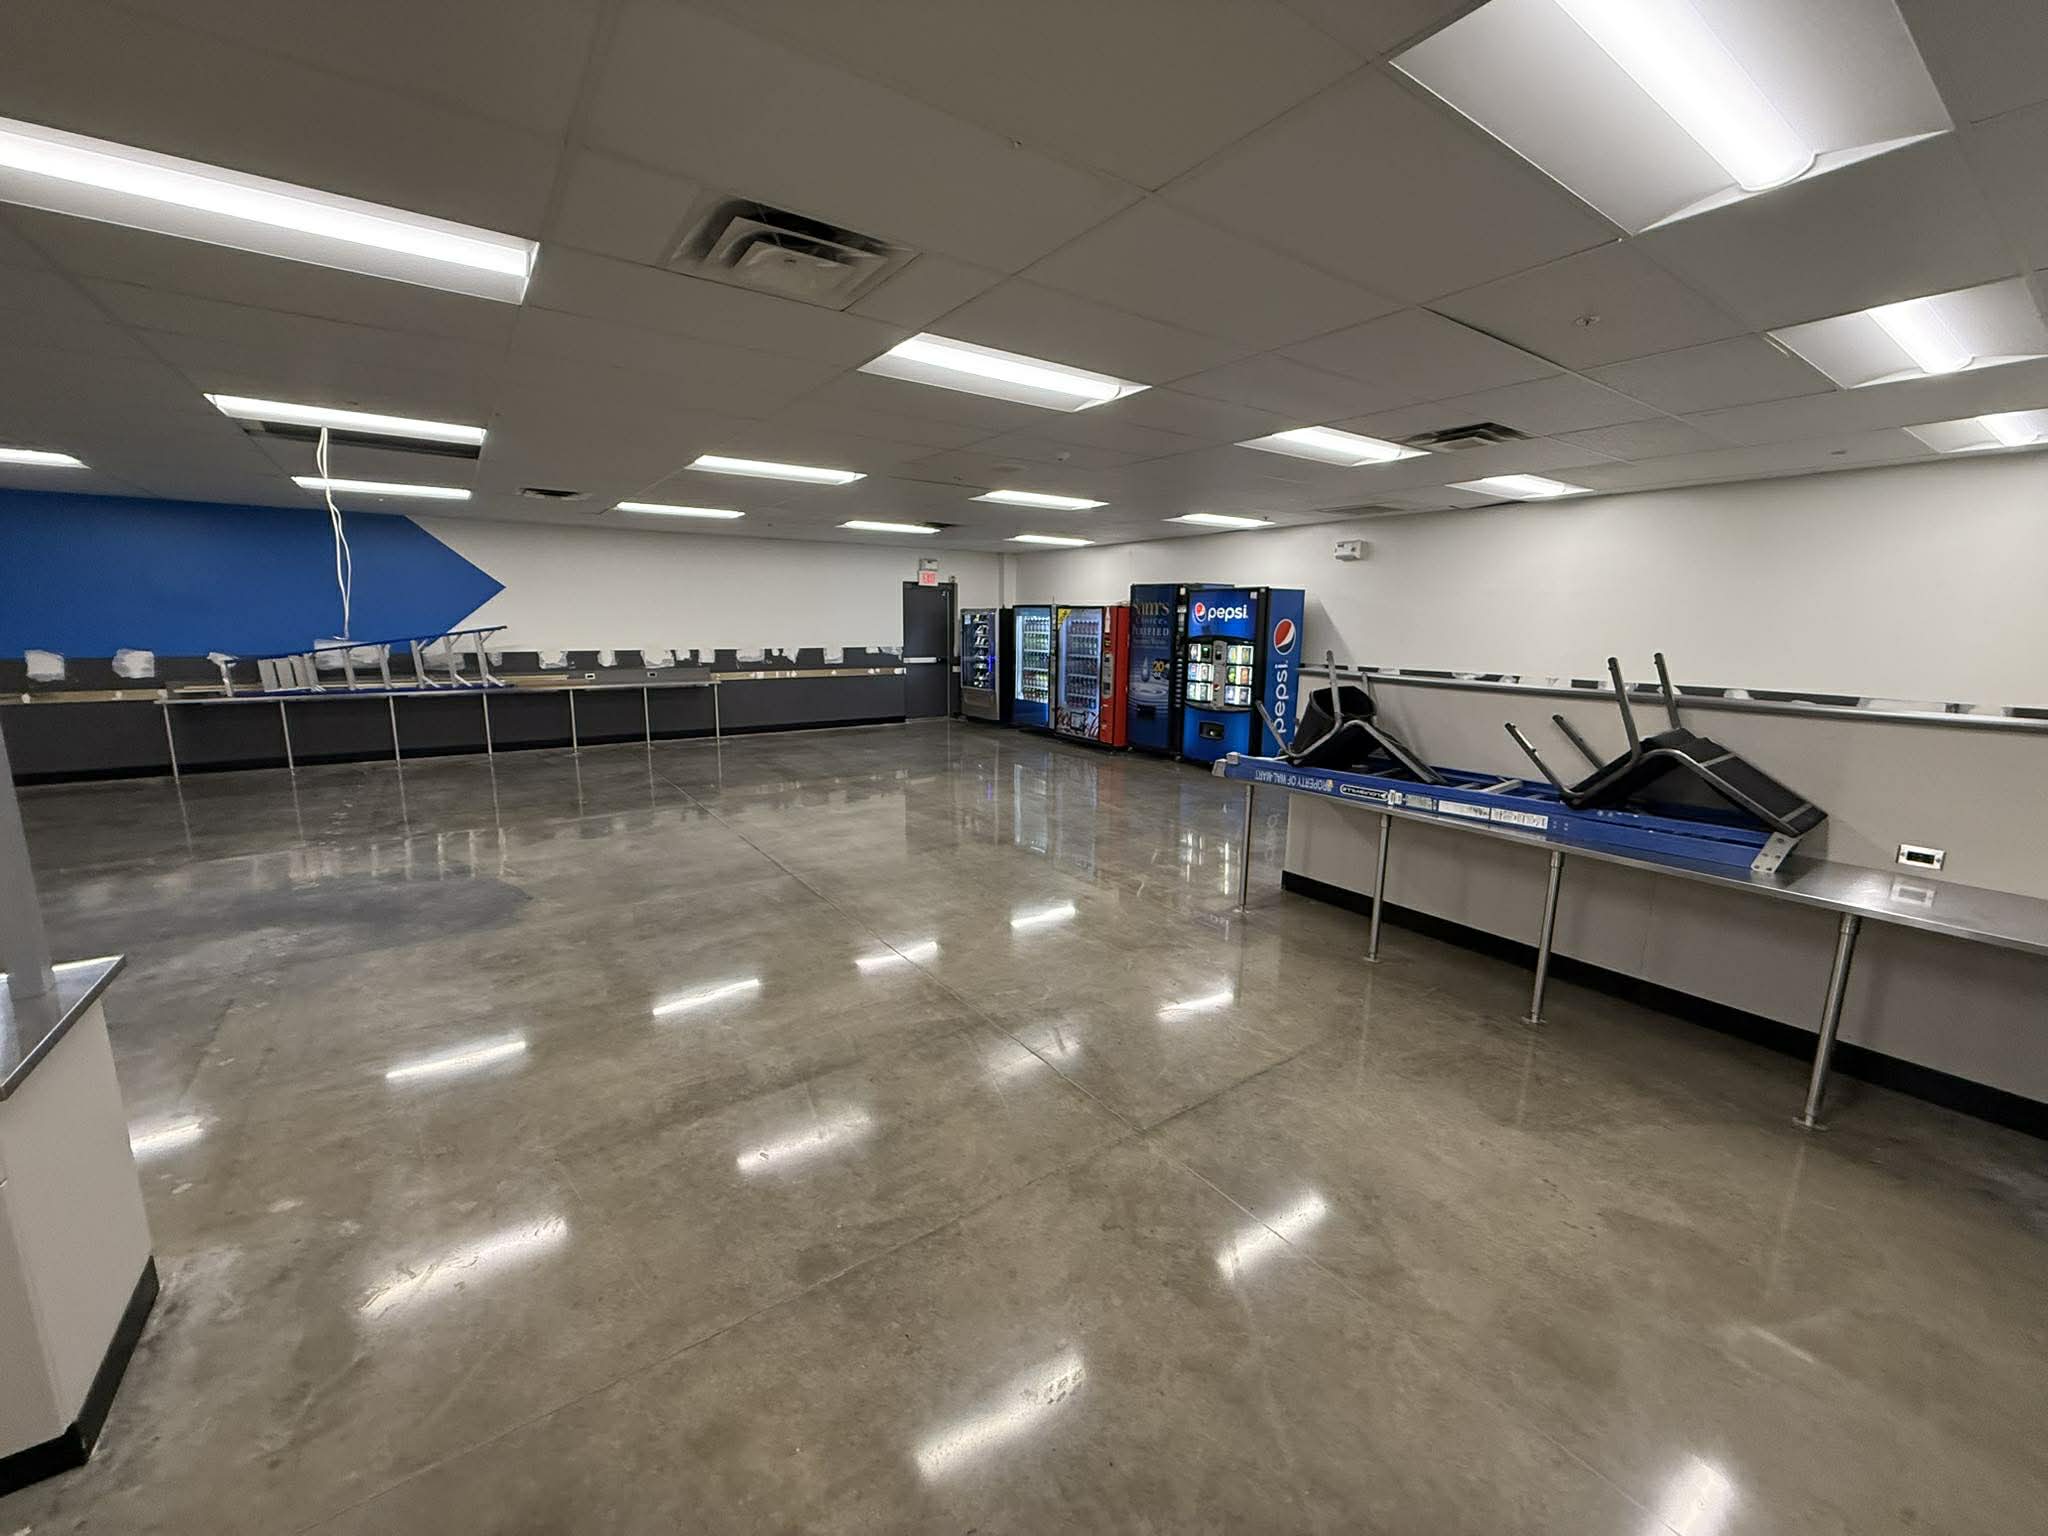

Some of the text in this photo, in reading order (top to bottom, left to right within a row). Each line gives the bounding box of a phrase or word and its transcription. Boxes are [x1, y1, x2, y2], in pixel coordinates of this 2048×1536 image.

[1207, 604, 1247, 622] pepsi
[1274, 664, 1288, 734] pepsi
[1286, 776, 1296, 786] OF
